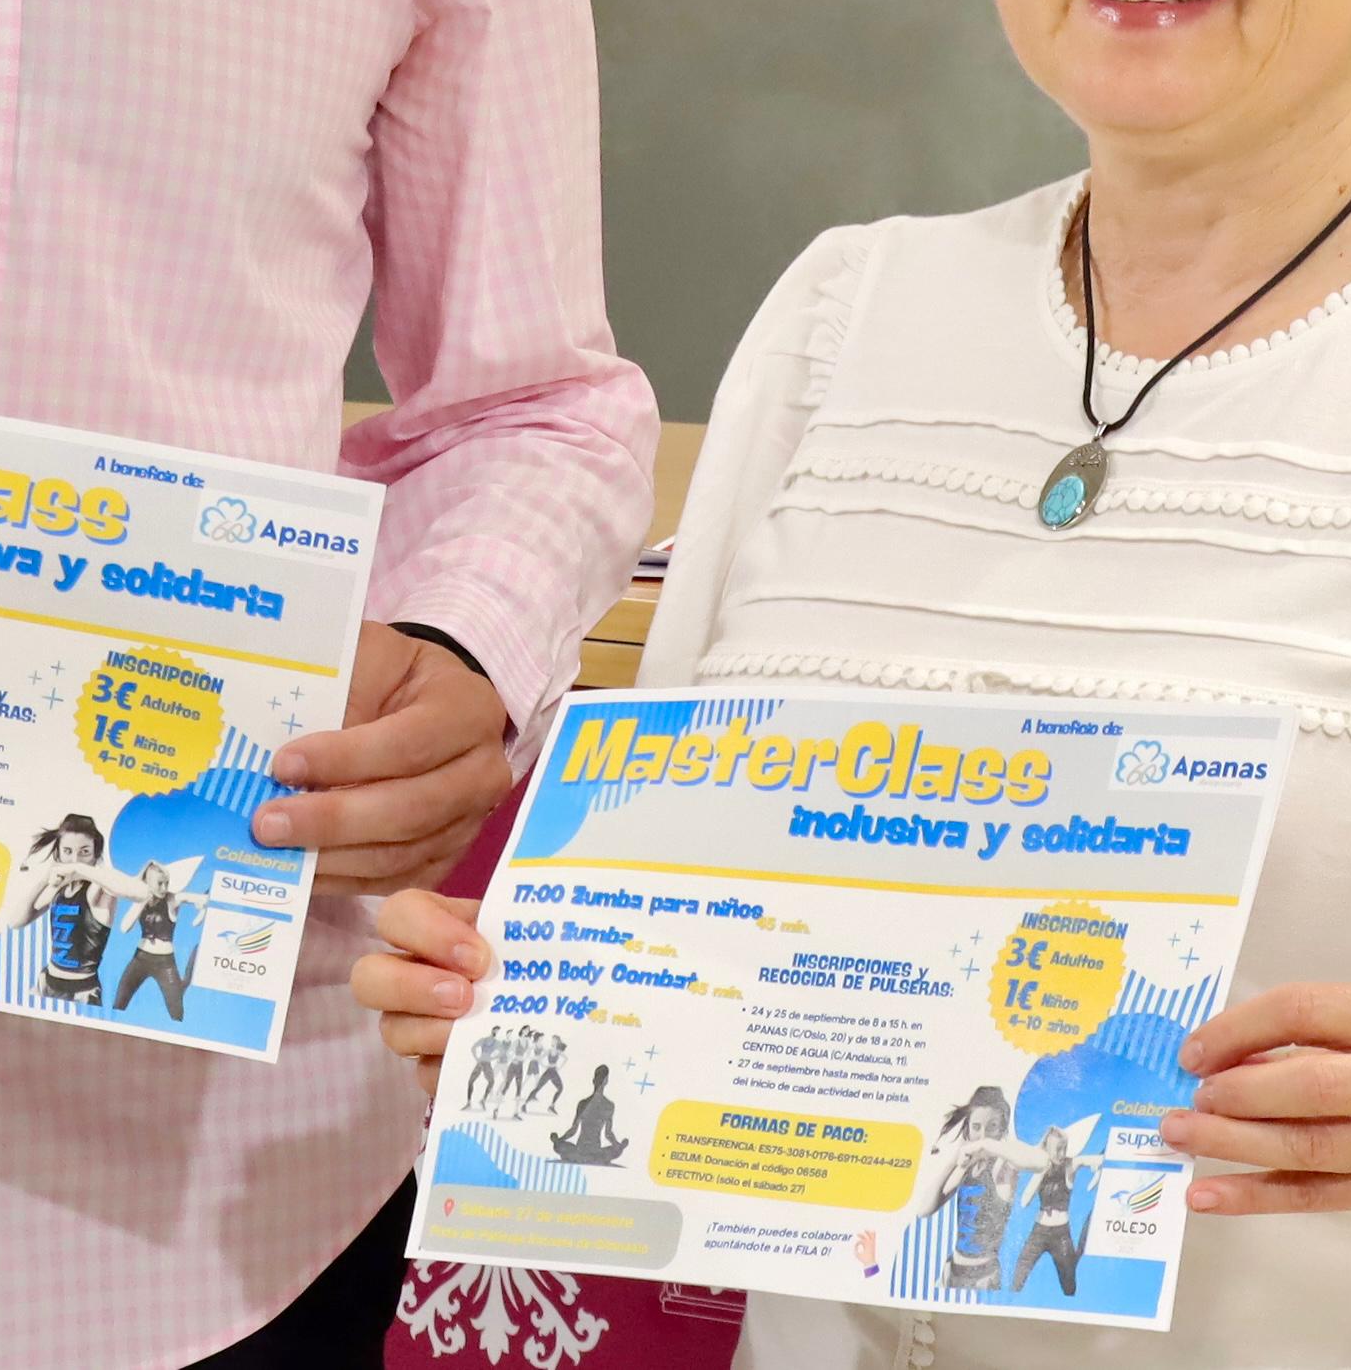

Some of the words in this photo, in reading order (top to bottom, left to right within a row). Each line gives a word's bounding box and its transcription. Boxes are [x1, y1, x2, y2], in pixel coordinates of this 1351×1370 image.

[94, 456, 106, 471] A
[110, 458, 178, 484] beneficio
[182, 472, 205, 489] de:
[259, 520, 359, 555] Apanas
[53, 554, 89, 592] y
[101, 561, 285, 621] solidaria
[106, 649, 224, 693] INSCRIPCIÓN
[92, 674, 138, 711] 3€
[140, 694, 201, 721] Adultos
[93, 714, 130, 749] 1€
[133, 734, 176, 757] Niños
[1021, 718, 1032, 734] A
[1035, 719, 1099, 735] beneficio
[1102, 721, 1124, 736] de:
[98, 750, 137, 769] 4-10
[141, 762, 179, 781] años
[560, 719, 1053, 807] MasterClass
[1171, 756, 1268, 782] Apanas
[788, 804, 970, 849] inclusiva
[977, 822, 1012, 861] y
[1021, 814, 1191, 856] solidaria
[216, 844, 297, 872] Colaboran
[221, 876, 287, 899] supera
[513, 884, 565, 904] 17:00
[571, 885, 644, 910] Zumba
[648, 896, 700, 916] para
[706, 897, 764, 922] niños
[504, 920, 554, 941] 18:00
[560, 921, 634, 947] Zumba
[1021, 911, 1128, 942] INSCRIPCIÓN
[212, 956, 267, 976] TOLEDO
[1006, 937, 1049, 971] 3€
[1050, 951, 1104, 970] Adultos
[503, 960, 553, 981] 19:00
[558, 960, 605, 986] Body
[611, 963, 698, 992] Combat
[792, 953, 913, 976] INSCRIPCIONES
[914, 967, 929, 984] y
[842, 974, 865, 990] DE
[869, 976, 954, 997] PULSERAS:
[1005, 979, 1039, 1011] 1€
[1041, 993, 1079, 1011] Niños
[490, 994, 549, 1015] 20:00
[555, 995, 598, 1021] Yoga
[751, 1006, 764, 1016] 24
[765, 1010, 772, 1019] y
[773, 1008, 787, 1019] 25
[788, 1010, 801, 1020] de
[803, 1013, 856, 1025] septiembre
[858, 1017, 871, 1027] de
[872, 1017, 879, 1028] 8
[889, 1019, 899, 1029] 15
[911, 1022, 923, 1030] en
[746, 1023, 788, 1037] APANAS
[789, 1028, 828, 1042] (C/Oslo,
[830, 1032, 847, 1043] 20)
[847, 1036, 854, 1045] y
[855, 1035, 868, 1044] de
[870, 1036, 881, 1046] 18
[890, 1037, 903, 1047] 20
[914, 1041, 926, 1049] en
[1008, 1014, 1042, 1031] 4-10
[1046, 1019, 1081, 1036] años
[742, 1041, 784, 1054] CENTRO
[785, 1046, 799, 1056] DE
[800, 1047, 828, 1059] AGUA
[737, 1058, 751, 1068] 27
[751, 1061, 765, 1070] de
[766, 1064, 821, 1076] septiembre
[822, 1068, 848, 1079] hasta
[850, 1072, 879, 1082] media
[881, 1073, 902, 1084] hora
[903, 1076, 929, 1086] antes
[732, 1076, 749, 1086] del
[750, 1078, 776, 1089] inicio
[777, 1081, 790, 1091] de
[792, 1084, 816, 1094] cada
[817, 1087, 861, 1098] actividad
[875, 1091, 884, 1101] la
[1113, 1100, 1188, 1117] Colabor
[720, 1112, 790, 1135] FORMAS
[795, 1122, 817, 1138] DE
[1116, 1132, 1164, 1149] supe
[706, 1222, 756, 1235] ¡También
[757, 1228, 799, 1238] puedes
[801, 1230, 853, 1242] colaborar
[1105, 1220, 1157, 1235] TOLEDO
[704, 1239, 771, 1252] apuntándote
[782, 1244, 793, 1254] la
[794, 1244, 818, 1256] FILA
